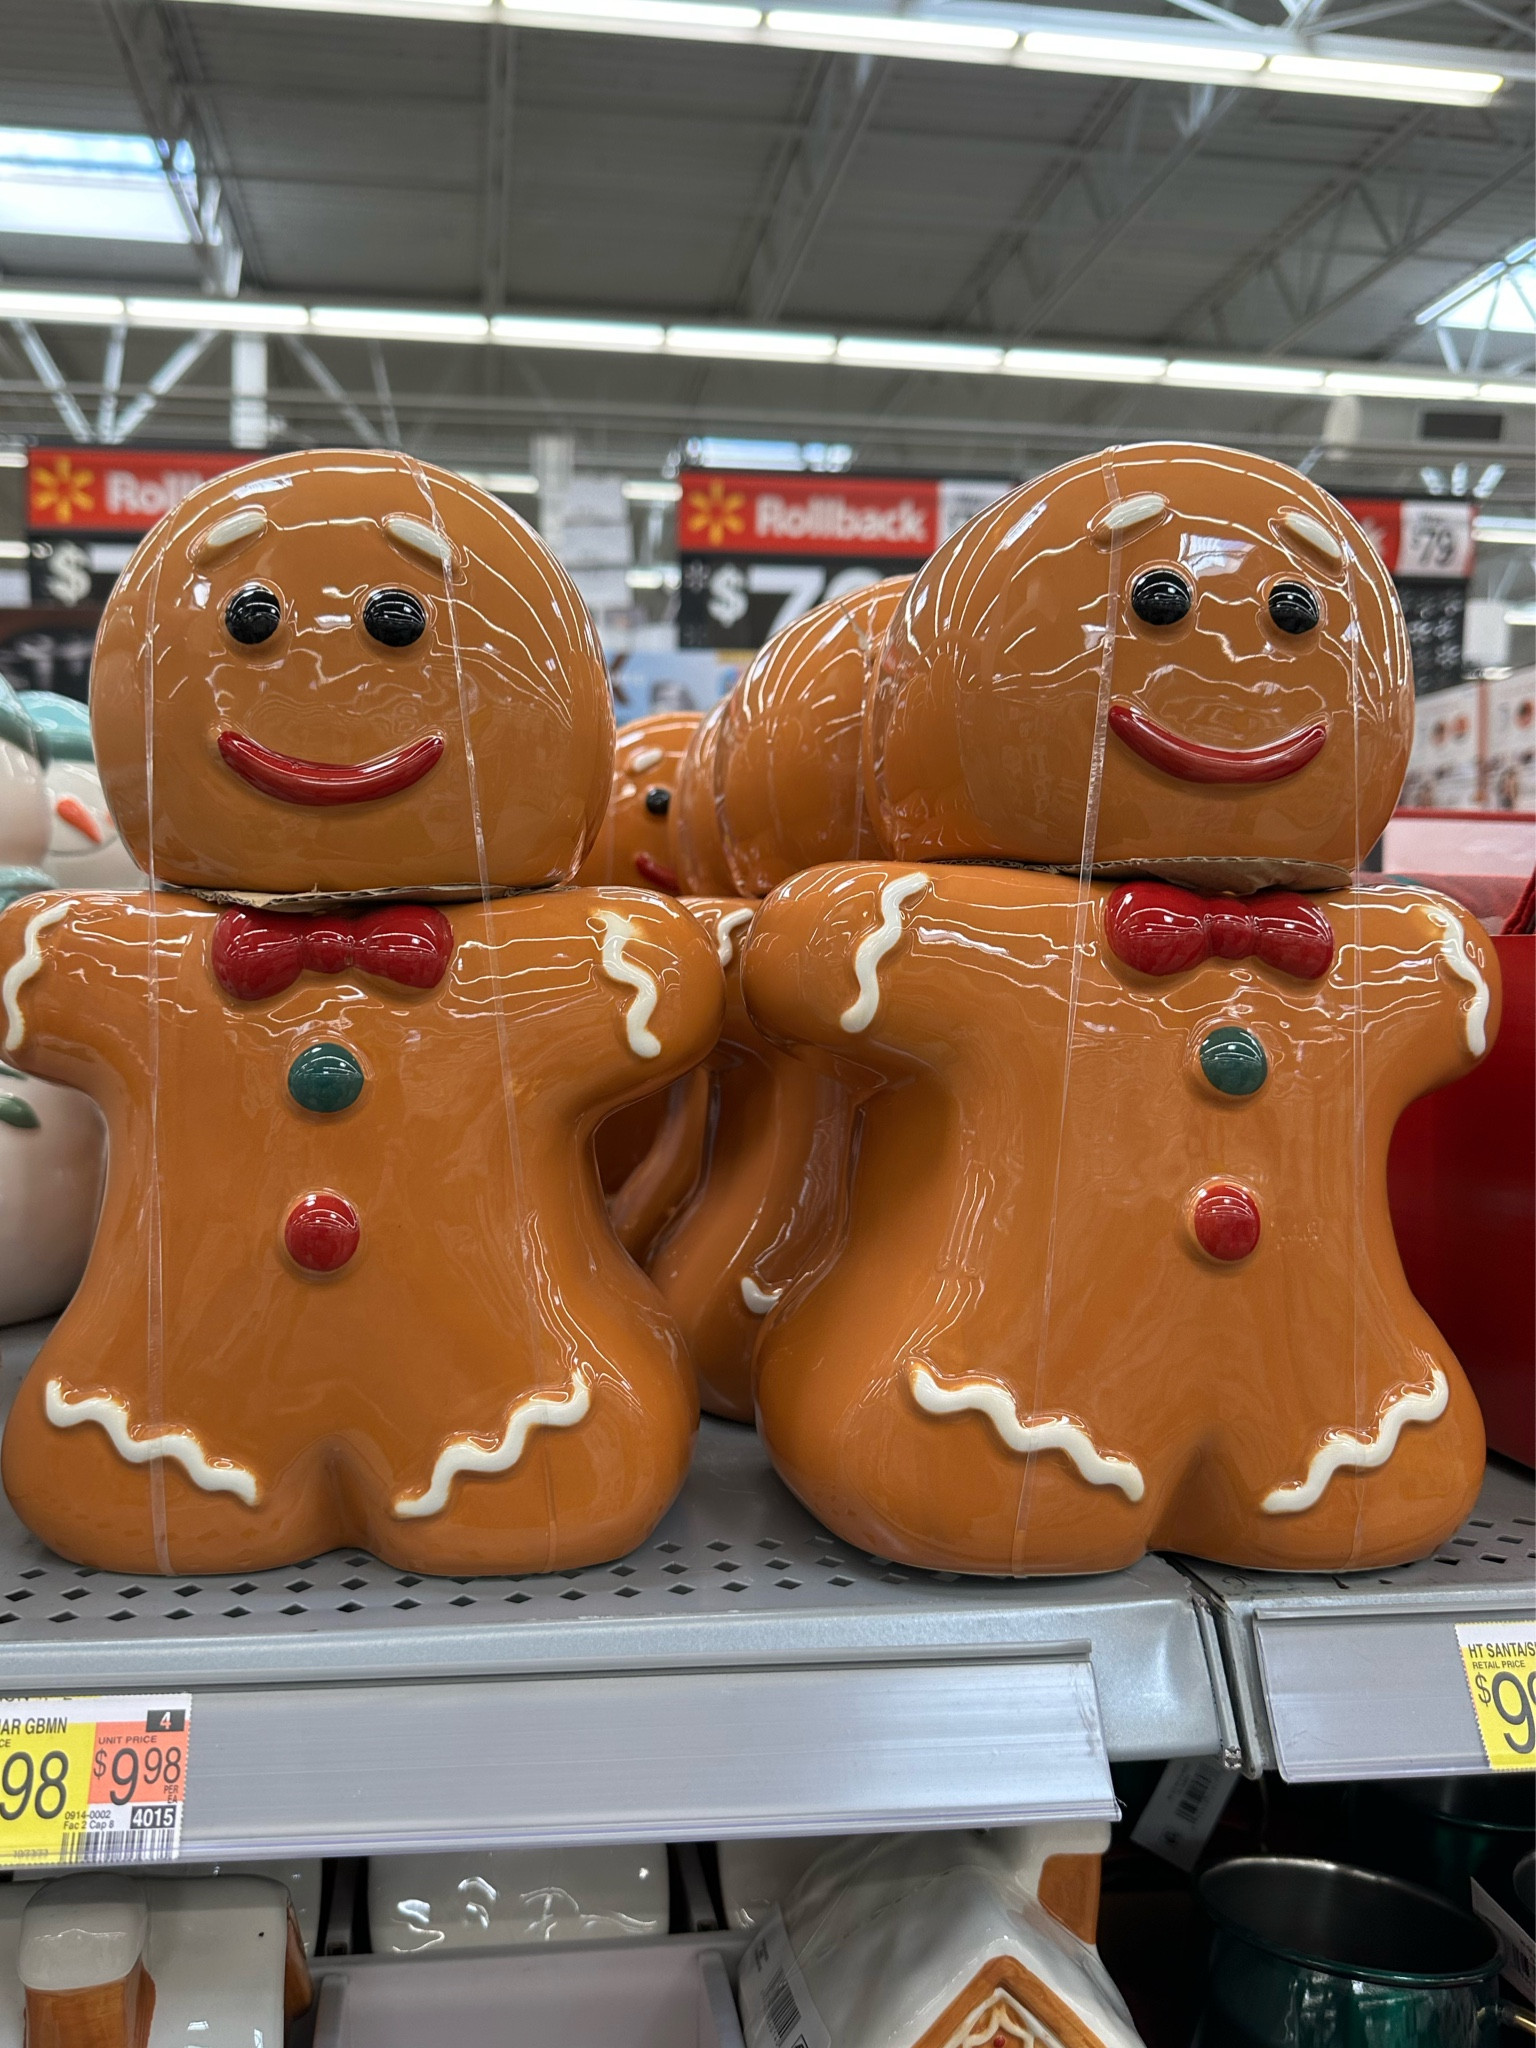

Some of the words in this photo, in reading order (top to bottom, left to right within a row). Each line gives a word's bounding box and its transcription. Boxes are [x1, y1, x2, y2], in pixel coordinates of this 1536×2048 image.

[103, 470, 206, 515] Roll
[755, 492, 929, 544] Rollback
[707, 562, 884, 645] $7
[1468, 1643, 1483, 1658] HT
[1487, 1641, 1536, 1657] SANTA/S
[1472, 1660, 1500, 1669] RETAIL
[1501, 1660, 1526, 1668] PRICE
[0, 1718, 21, 1735] AR
[25, 1717, 68, 1735] GBMN
[159, 1711, 172, 1730] 4
[98, 1736, 123, 1744] UNIT
[125, 1735, 157, 1744] PRICE
[163, 1785, 179, 1794] PER
[167, 1794, 178, 1804] EA
[65, 1810, 111, 1820] 0914-0002
[132, 1807, 174, 1827] 4015
[63, 1821, 79, 1830] Fac
[81, 1820, 87, 1829] 2
[89, 1820, 106, 1831] Cap
